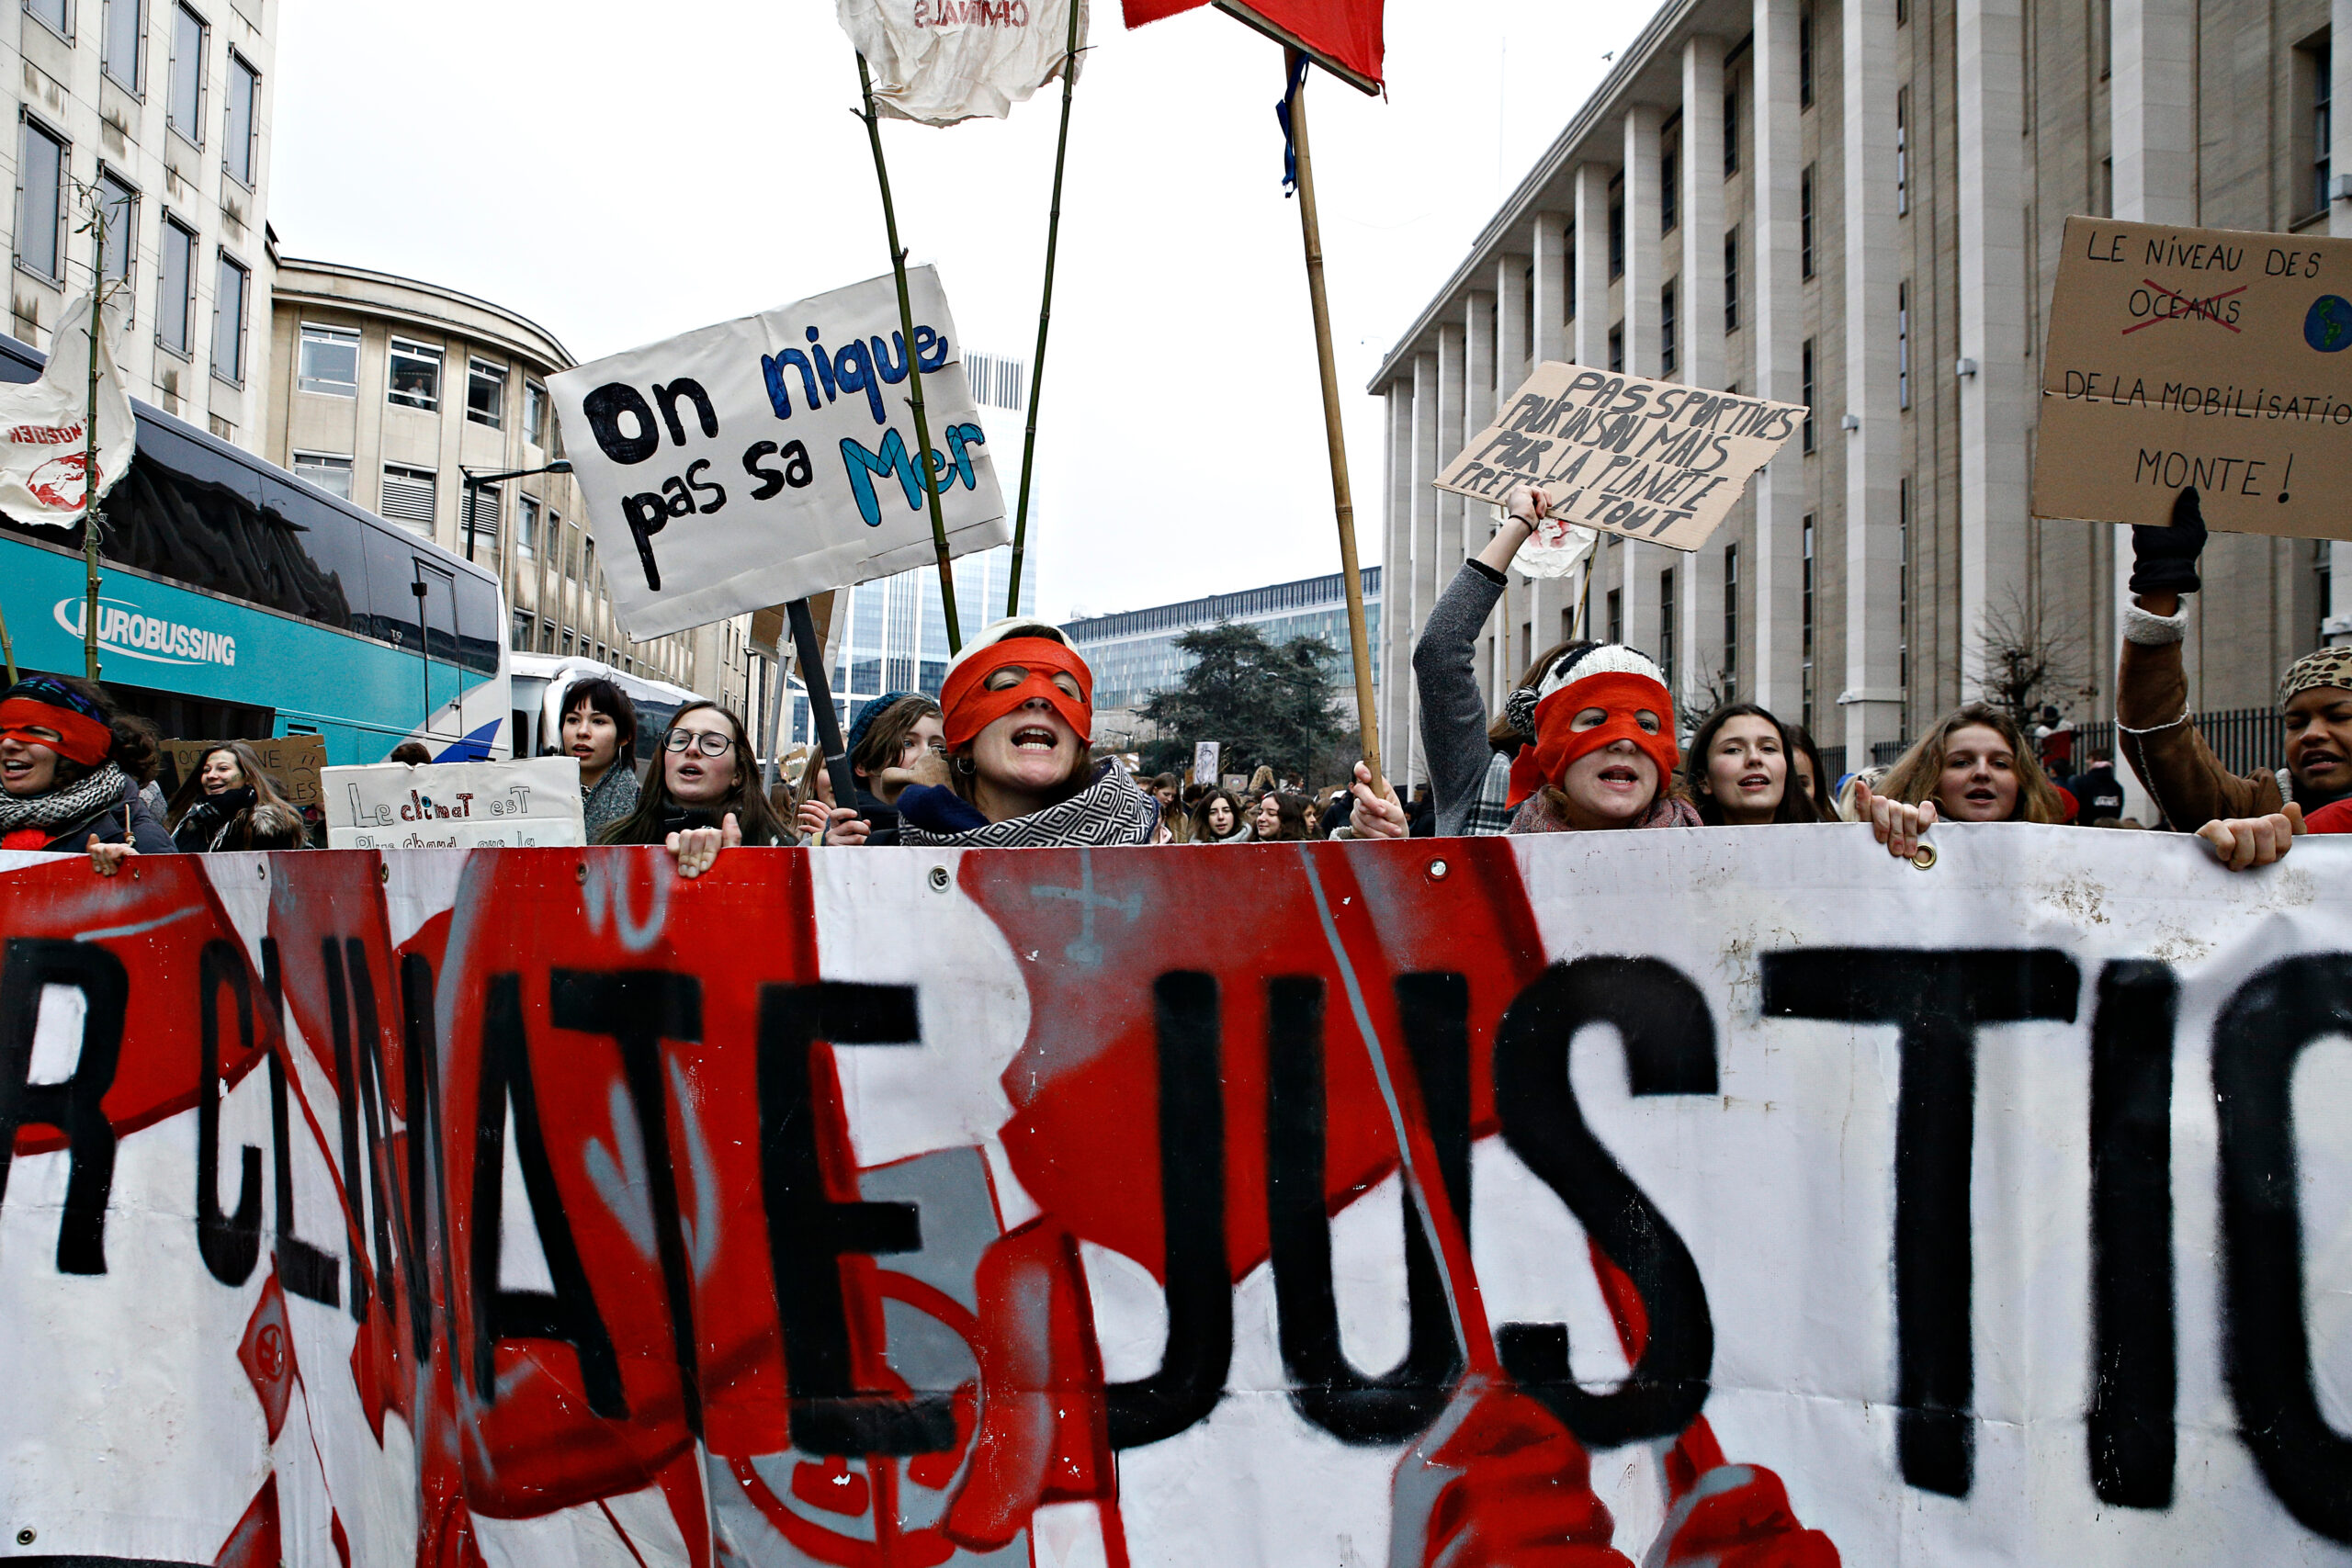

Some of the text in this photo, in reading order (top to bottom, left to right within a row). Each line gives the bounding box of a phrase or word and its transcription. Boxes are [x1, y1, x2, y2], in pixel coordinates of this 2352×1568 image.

[2087, 231, 2127, 262] LE
[2266, 249, 2322, 278] DES
[2129, 289, 2241, 324] OCÉANS
[761, 324, 949, 425] nique
[1559, 372, 1654, 413] PAS
[2066, 370, 2101, 402] DE
[2112, 376, 2147, 408] LA
[1498, 393, 1574, 434] POUR
[1473, 431, 1554, 473] POUR
[1544, 446, 1594, 484] LA
[2135, 448, 2266, 496] MONTE
[622, 422, 986, 592] pas sa Mer
[1449, 462, 1556, 500] PRÊT
[1584, 493, 1693, 537] TOUT
[348, 783, 394, 828] Le
